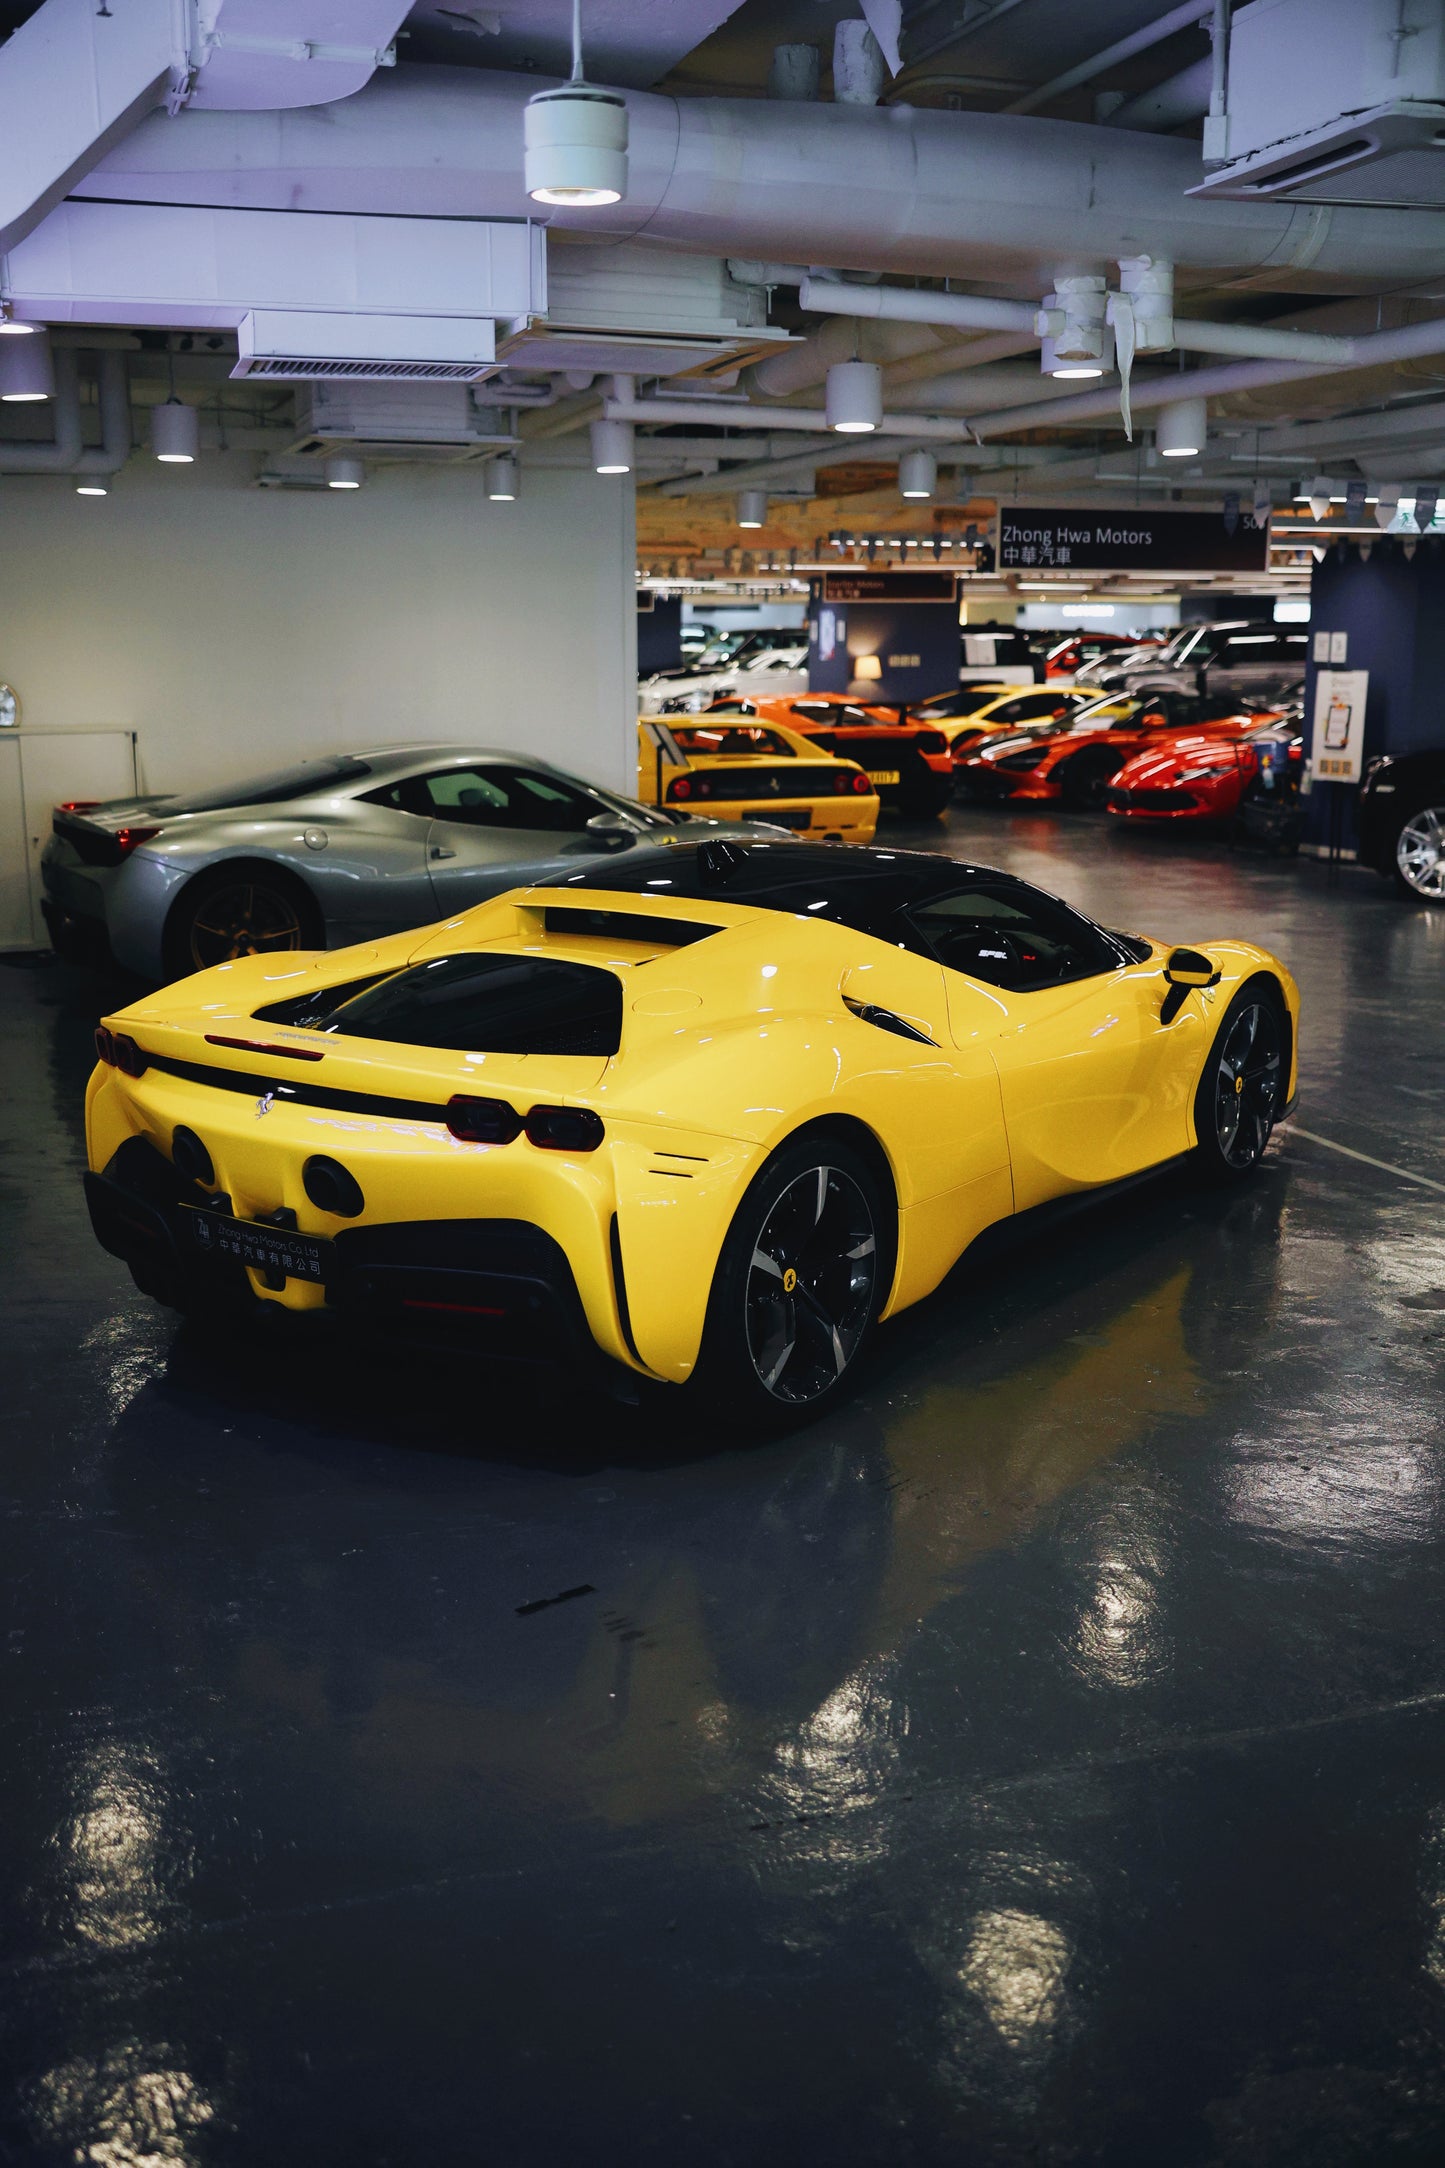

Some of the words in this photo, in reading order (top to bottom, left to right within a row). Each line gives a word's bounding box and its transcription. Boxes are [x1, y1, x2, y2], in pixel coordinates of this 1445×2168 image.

[1242, 516, 1266, 530] 50
[1002, 525, 1052, 547] Zhong
[1057, 528, 1091, 544] Hwa
[1096, 528, 1153, 545] Motors
[1003, 547, 1072, 566] 中華汽車
[219, 1239, 321, 1275] 中華汽車有限公司
